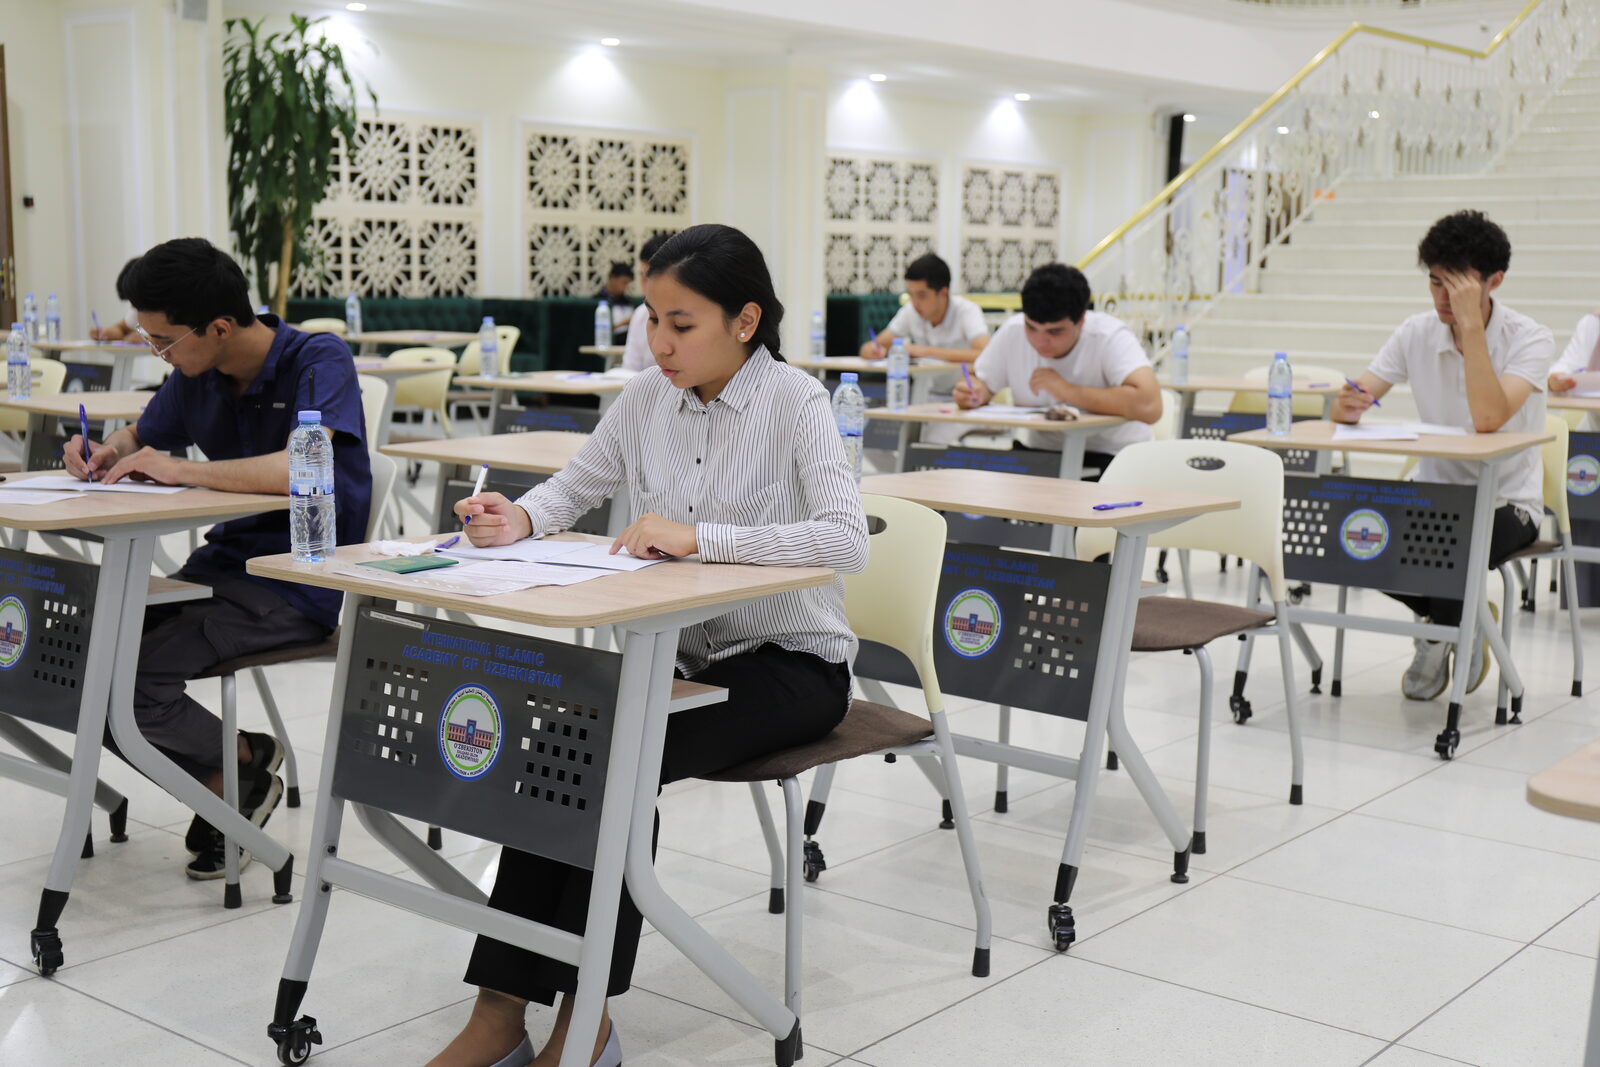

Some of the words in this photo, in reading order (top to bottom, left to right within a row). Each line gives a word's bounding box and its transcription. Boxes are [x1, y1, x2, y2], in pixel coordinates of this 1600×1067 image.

[402, 645, 459, 670] ACADEMY
[462, 657, 479, 670] OF
[483, 661, 562, 688] UZBEKISTAN
[421, 631, 491, 656] INTERNATIONAL
[495, 645, 545, 667] ISLAMIC
